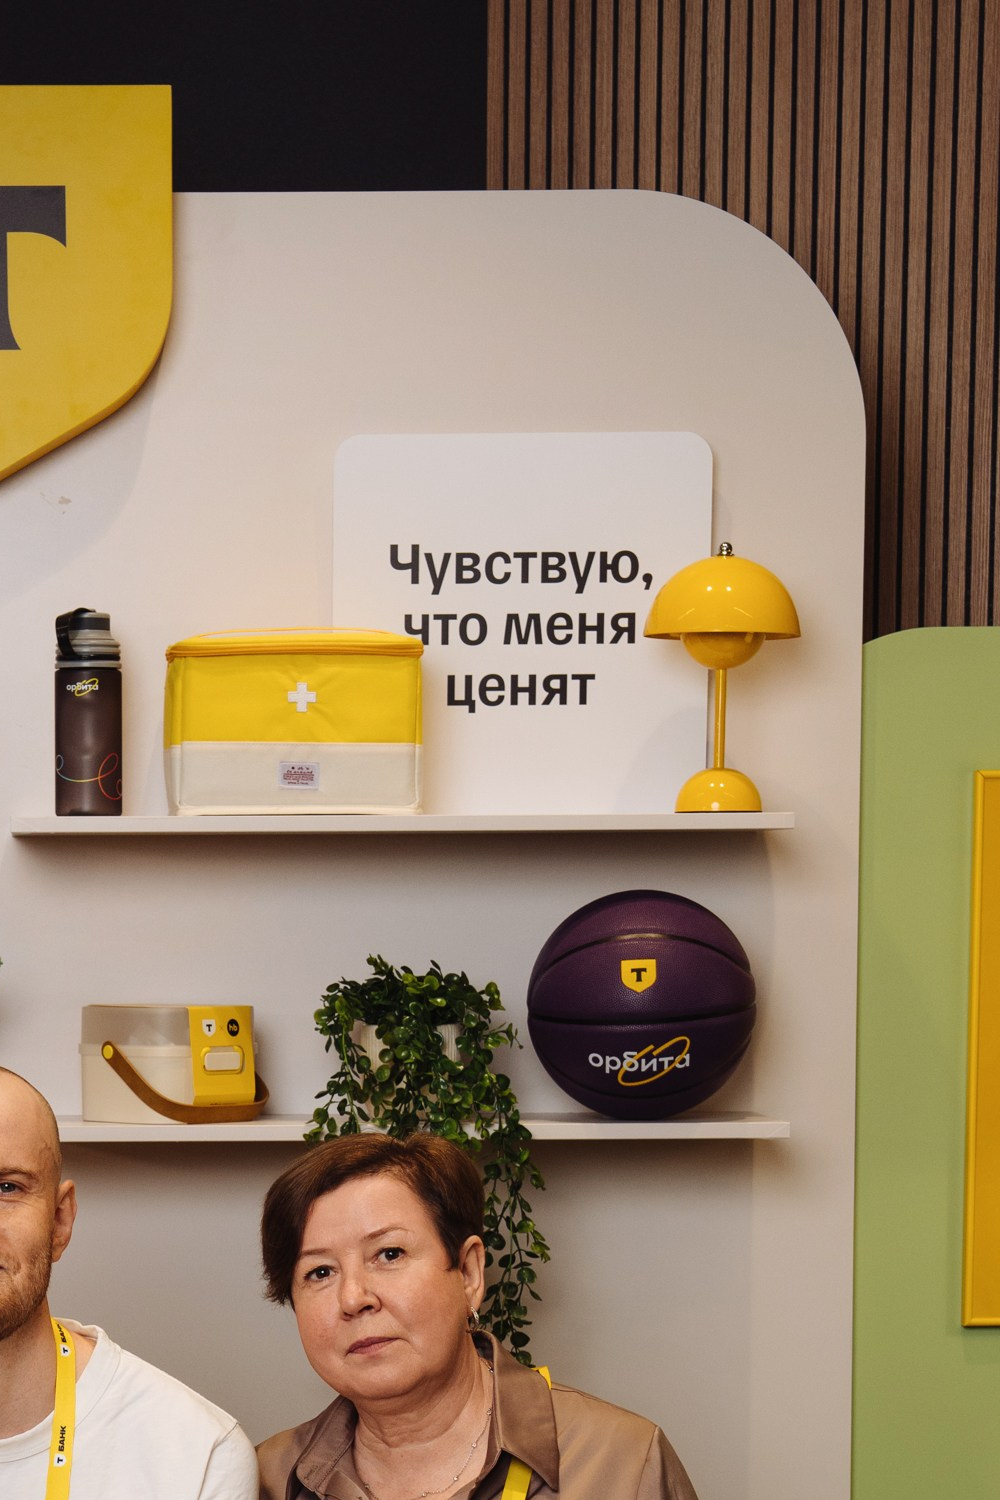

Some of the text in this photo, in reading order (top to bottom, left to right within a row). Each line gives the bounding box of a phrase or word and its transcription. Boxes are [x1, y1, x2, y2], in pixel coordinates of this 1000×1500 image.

[389, 543, 653, 595] Чувствую,
[404, 611, 636, 646] что меня
[446, 673, 596, 714] ценят
[57, 1425, 67, 1452] БАНК
